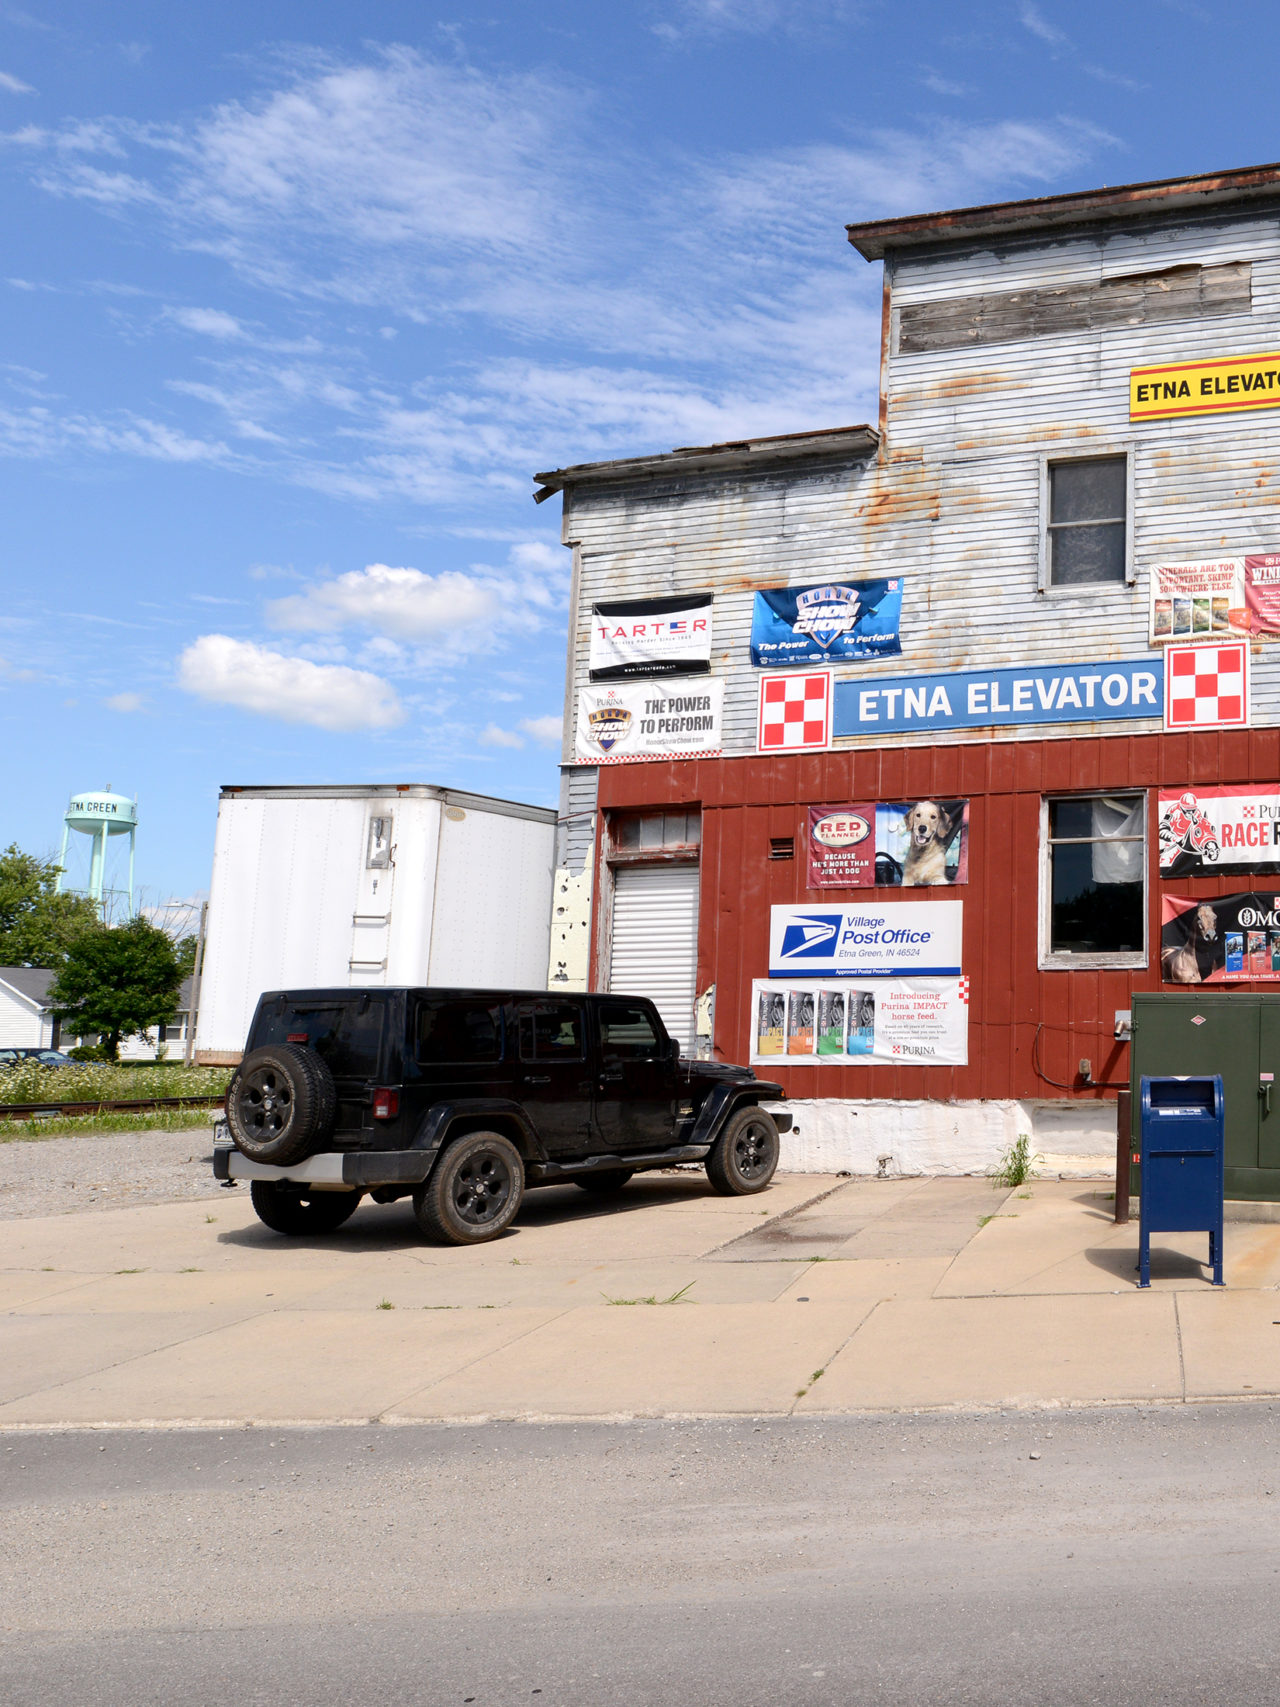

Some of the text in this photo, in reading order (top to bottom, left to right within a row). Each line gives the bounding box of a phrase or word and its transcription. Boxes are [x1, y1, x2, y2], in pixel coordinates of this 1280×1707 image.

[1137, 380, 1191, 402] ETNA
[1200, 564, 1216, 572] ARE
[1218, 563, 1235, 571] TOO
[1207, 572, 1234, 582] SKIMP
[1211, 582, 1234, 591] ELSE.
[802, 590, 853, 603] HONOR
[798, 602, 861, 620] SHOW
[792, 617, 857, 634] CHOW
[758, 633, 895, 651] The Power to Perform
[597, 698, 623, 706] PURINA
[859, 672, 1157, 721] ETNA ELEVATOR
[645, 696, 711, 714] THE POWER
[592, 710, 628, 720] HONOR
[590, 721, 632, 731] SHOW
[640, 715, 713, 734] TO PERFORM
[586, 731, 631, 741] CHOW
[87, 802, 118, 813] GREEN
[820, 822, 861, 832] RED
[1221, 822, 1269, 847] RACE
[847, 917, 885, 929] Village
[842, 929, 931, 944] Post Office
[858, 949, 884, 958] Green,
[886, 949, 895, 957] IN
[896, 949, 920, 957] 46524
[890, 992, 941, 1001] Introducing
[881, 1001, 948, 1010] Purina IMPACT
[917, 1012, 938, 1020] feed.
[902, 1045, 935, 1056] PURINA
